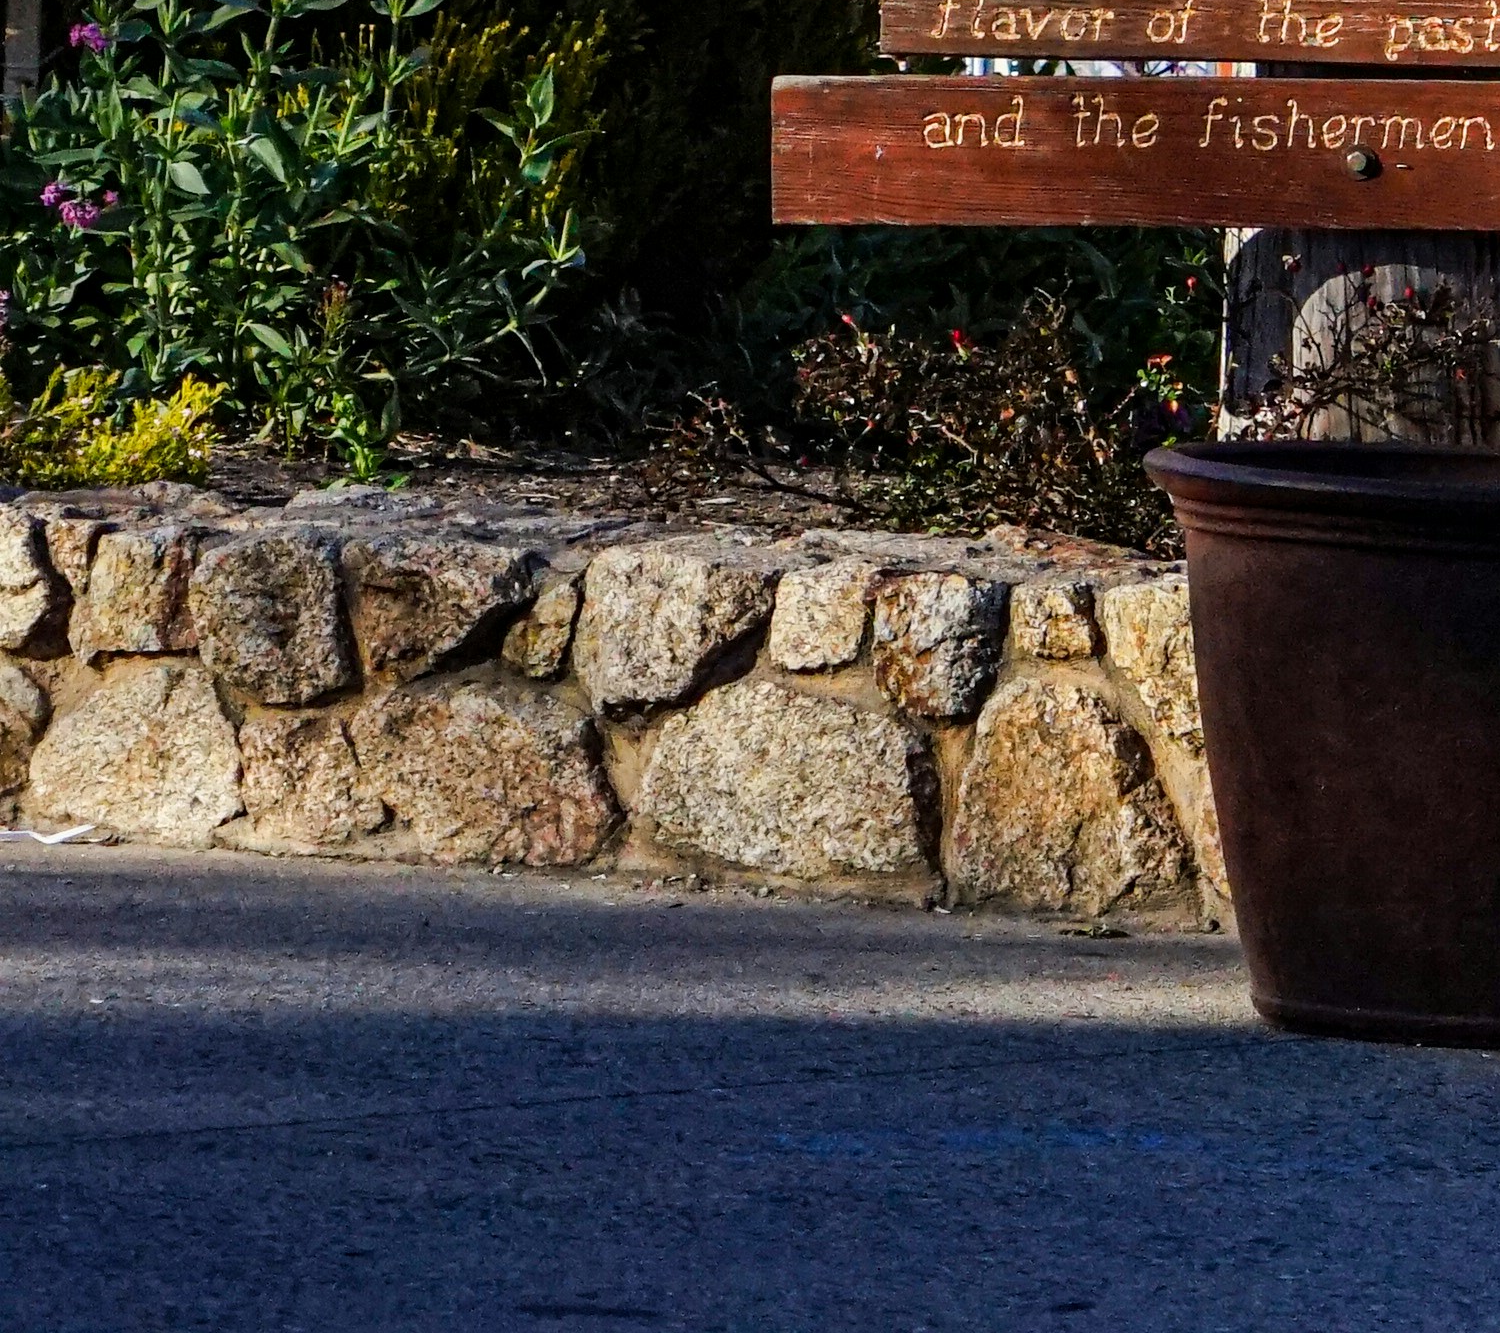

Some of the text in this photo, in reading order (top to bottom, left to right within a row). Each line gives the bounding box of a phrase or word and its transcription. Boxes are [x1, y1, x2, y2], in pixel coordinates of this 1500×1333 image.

[922, 94, 1026, 149] and
[1071, 92, 1160, 148] the
[1199, 96, 1496, 151] fishermen
